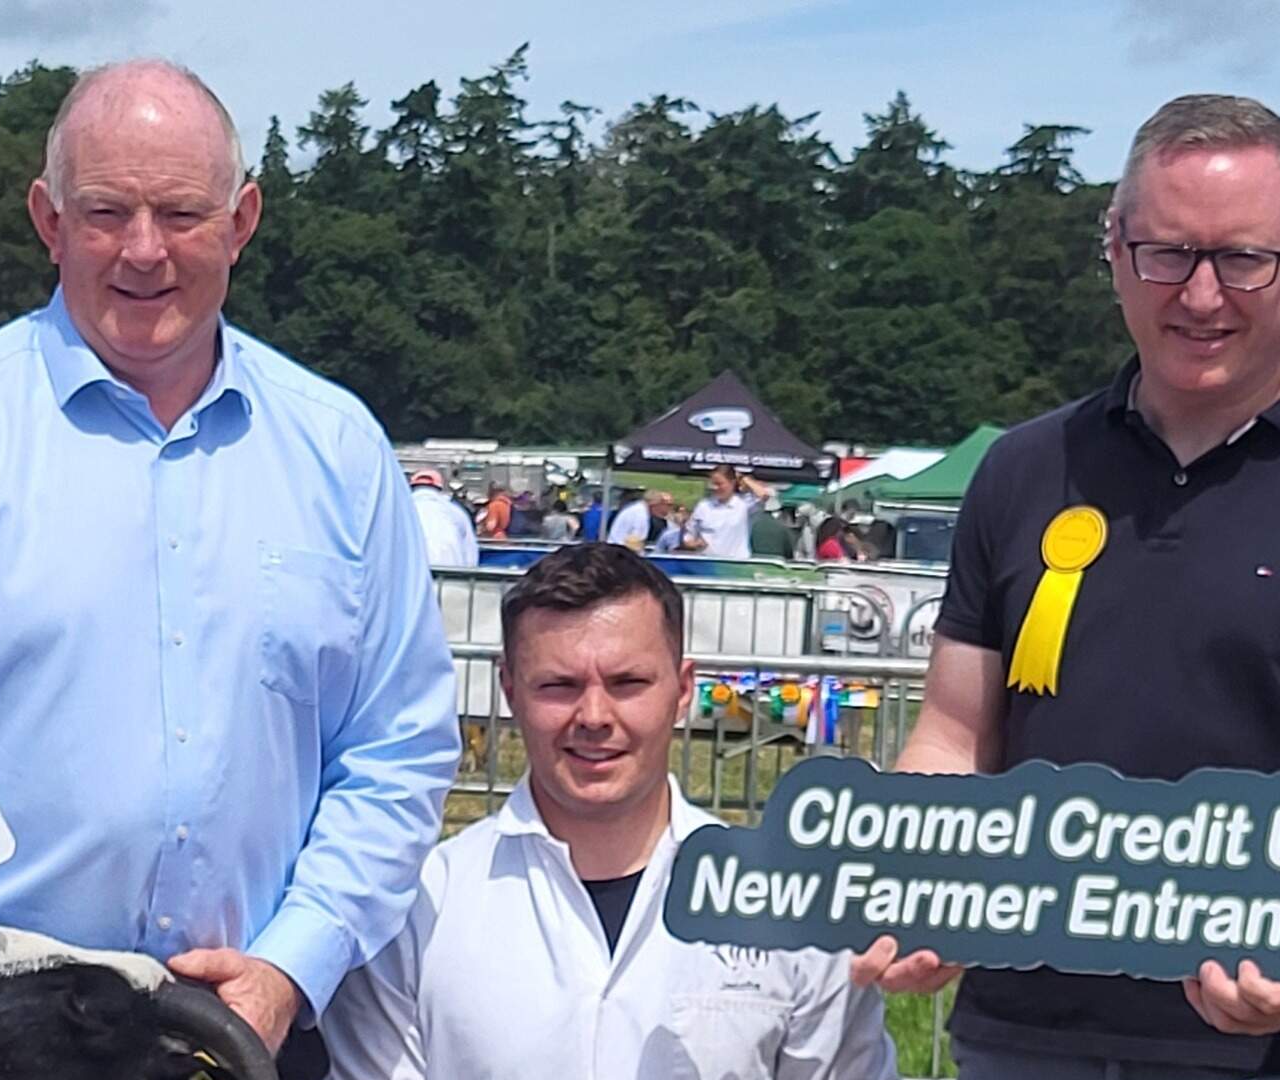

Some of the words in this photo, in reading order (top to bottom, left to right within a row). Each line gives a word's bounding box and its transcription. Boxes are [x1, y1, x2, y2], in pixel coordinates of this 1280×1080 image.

[788, 787, 1037, 857] Clonmel
[1048, 797, 1253, 868] Credit
[688, 853, 820, 918] New
[830, 861, 1057, 933] Farmer
